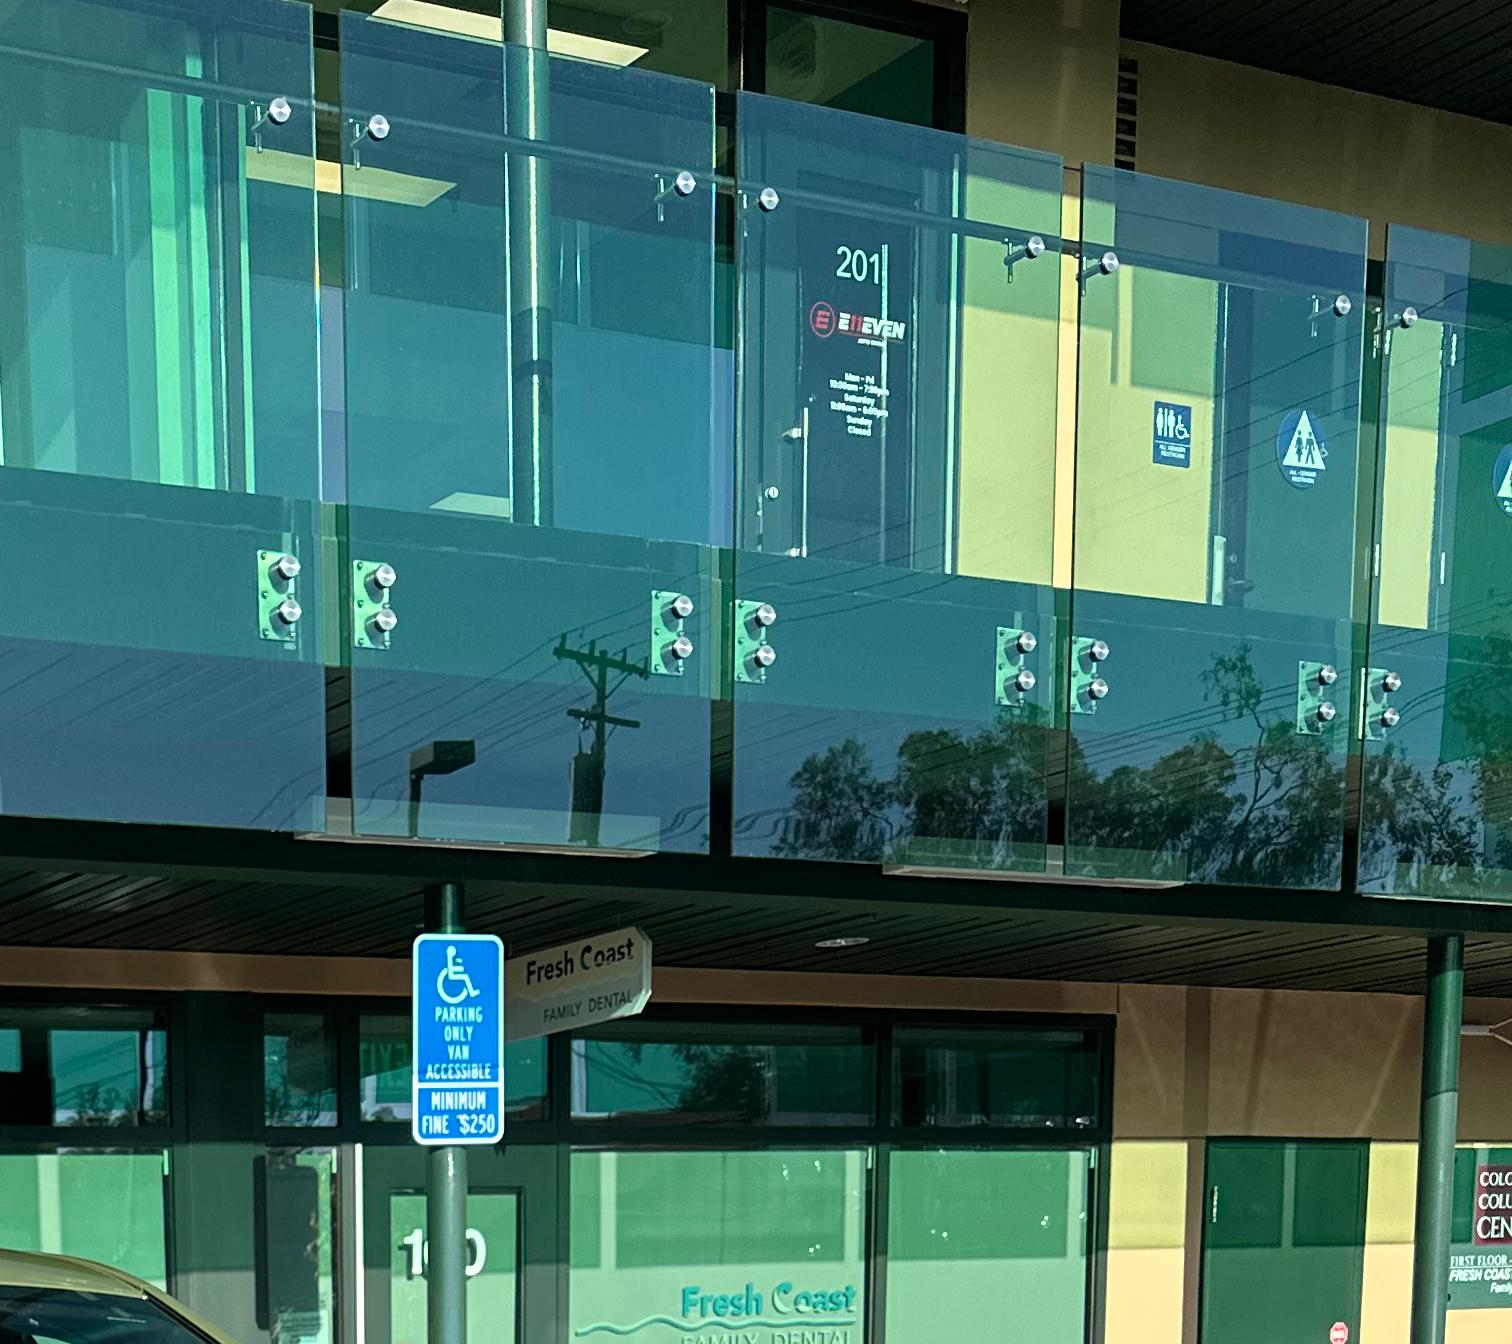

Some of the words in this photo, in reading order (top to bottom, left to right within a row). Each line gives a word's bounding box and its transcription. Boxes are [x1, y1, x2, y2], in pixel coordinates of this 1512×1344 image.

[836, 246, 880, 285] 201
[526, 950, 574, 985] Fresh
[580, 937, 634, 970] Coast
[434, 1006, 483, 1024] PARKING
[543, 1002, 582, 1024] FAMILY
[588, 991, 633, 1013] DENTAL
[443, 1026, 474, 1042] ONLY
[447, 1045, 470, 1060] VAN
[425, 1063, 492, 1080] ACCESSIBLE
[431, 1091, 486, 1111] MINIMUM
[421, 1115, 450, 1134] FINE
[457, 1113, 496, 1135] $250
[1450, 1255, 1475, 1268] FIRST
[1478, 1254, 1508, 1267] FLOOR
[1449, 1268, 1483, 1281] FRESH
[1484, 1268, 1512, 1280] COAS
[681, 1282, 763, 1318] Fresh
[772, 1281, 857, 1314] Coast
